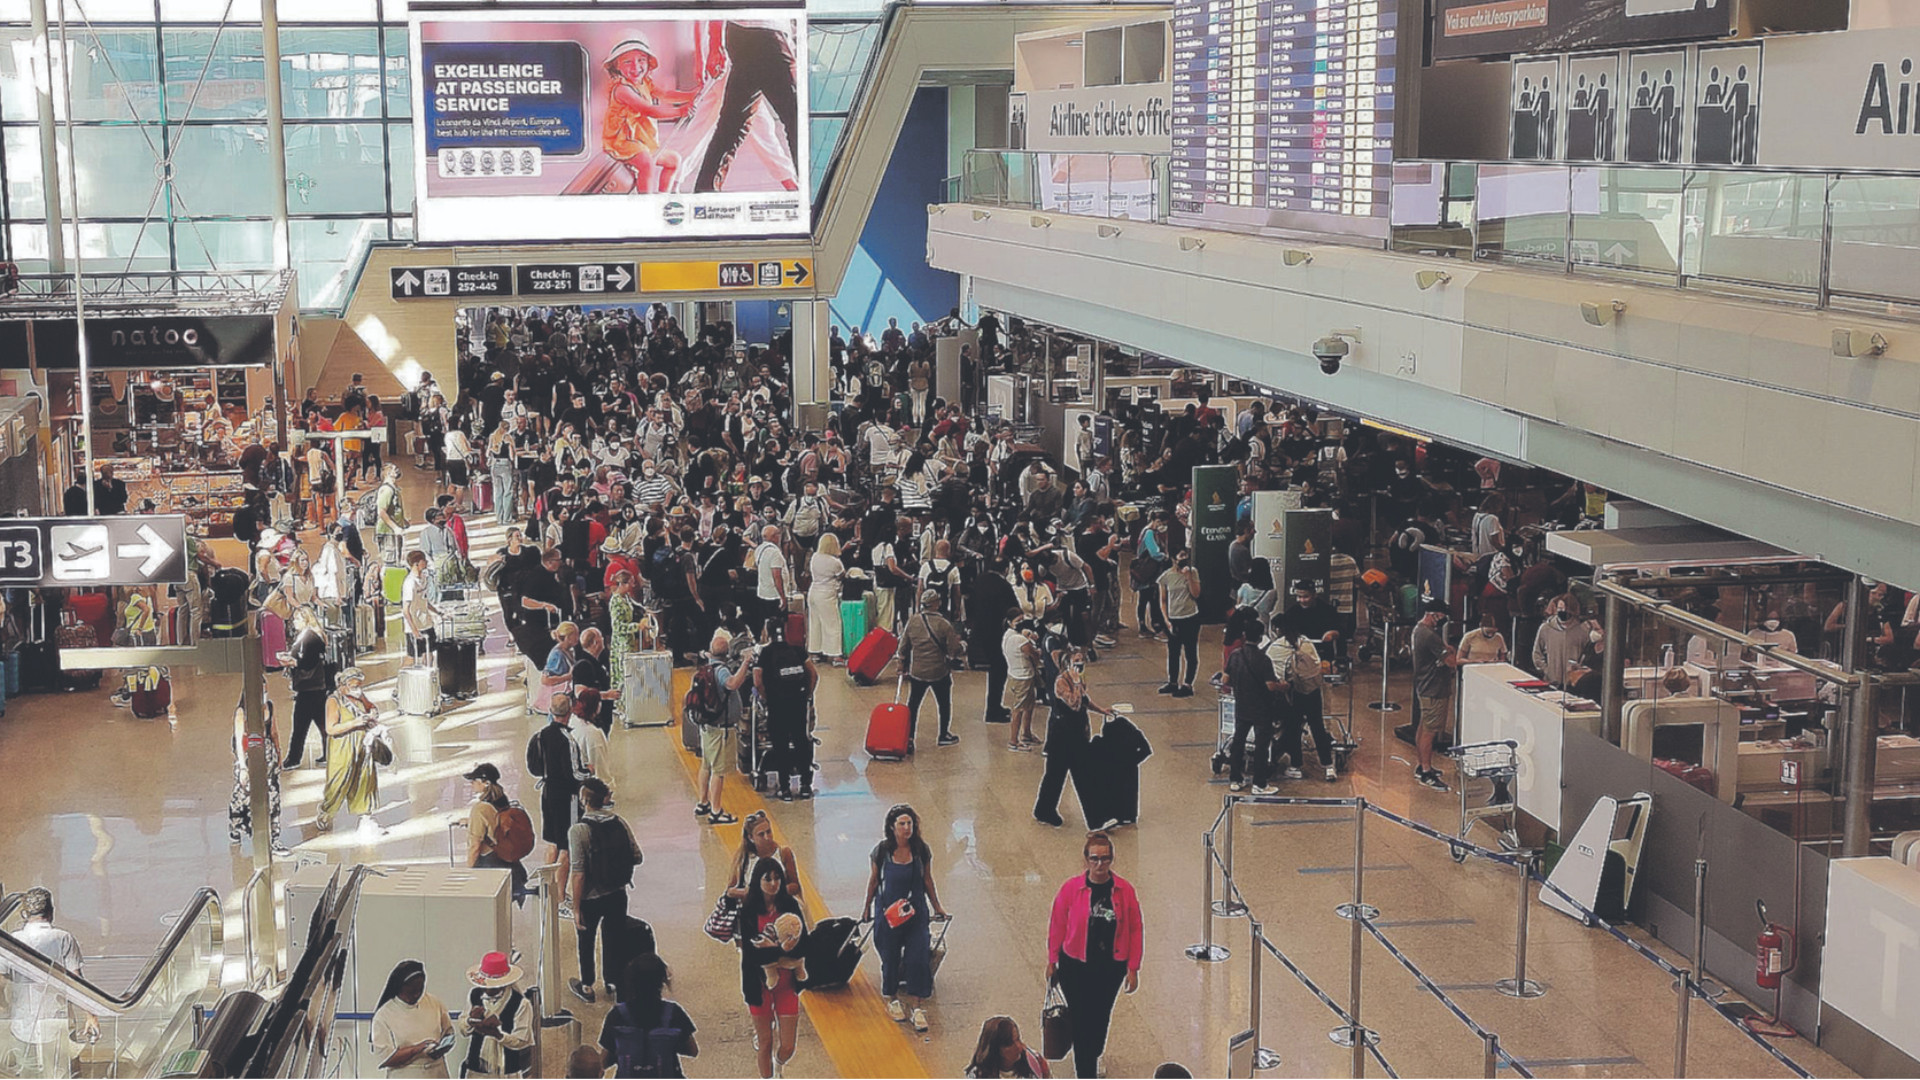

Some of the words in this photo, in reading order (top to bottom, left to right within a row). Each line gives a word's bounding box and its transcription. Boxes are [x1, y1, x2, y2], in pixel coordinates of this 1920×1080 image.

[1459, 18, 1469, 29] su
[1469, 3, 1546, 28] adr.it/easyparking
[434, 63, 544, 78] EXCELLENCE
[435, 81, 458, 95] AT
[460, 80, 562, 95] PASSENGER
[1855, 58, 1920, 134] Ai
[435, 97, 509, 111] SERVICE
[472, 118, 481, 127] da
[1050, 102, 1091, 136] Airline
[1094, 100, 1133, 136] ticket
[457, 271, 500, 281] Check-in
[530, 269, 572, 280] Check-in
[457, 282, 498, 292] 252-445
[533, 280, 572, 290] 226-251
[0, 540, 33, 568] T3
